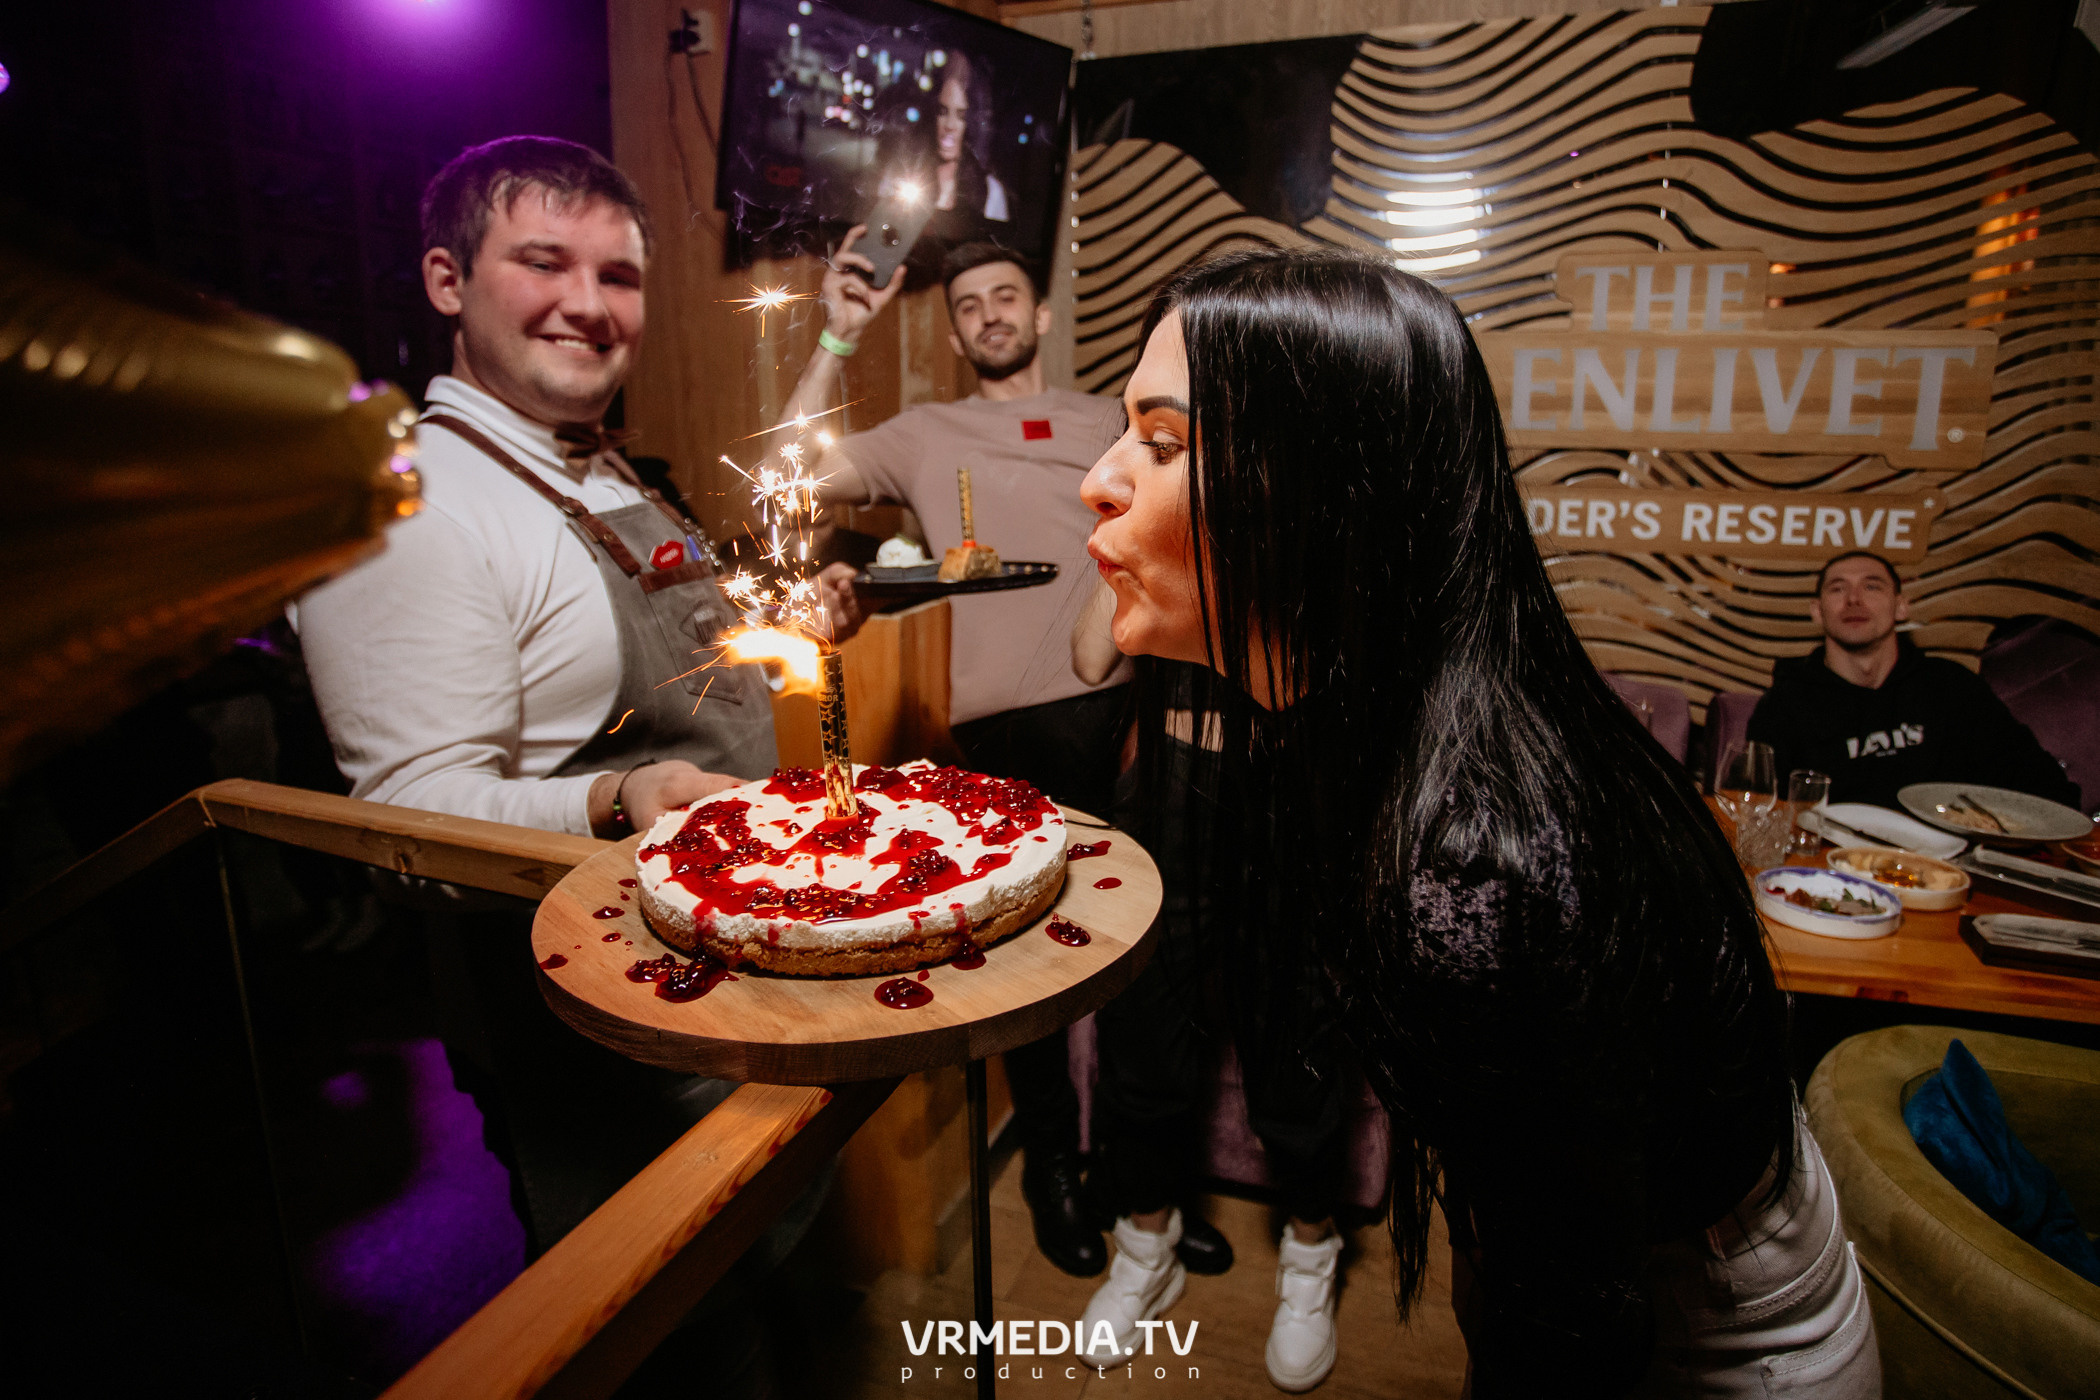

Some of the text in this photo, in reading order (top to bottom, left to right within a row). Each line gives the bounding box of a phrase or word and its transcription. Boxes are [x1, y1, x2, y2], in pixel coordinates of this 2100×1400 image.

[1575, 262, 1750, 334] THE
[1511, 346, 1976, 452] ENLIVET
[1527, 498, 1916, 549] DER'S RESERVE
